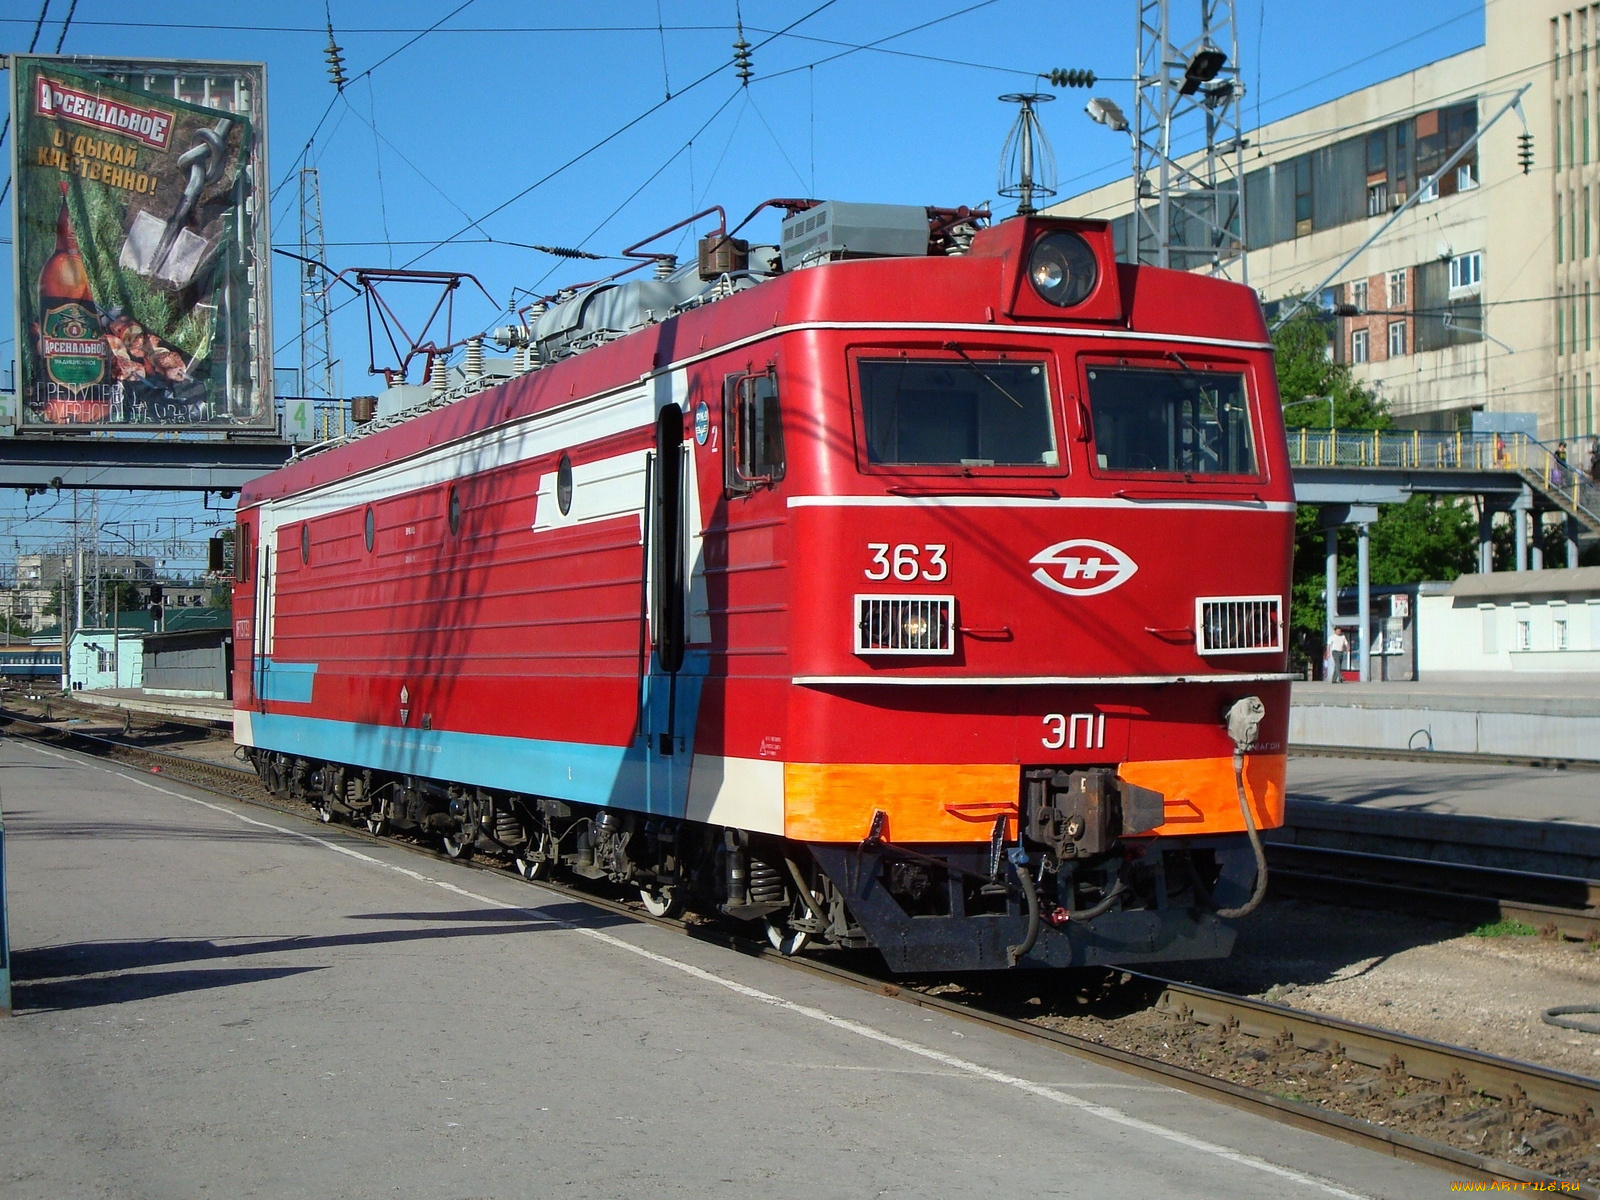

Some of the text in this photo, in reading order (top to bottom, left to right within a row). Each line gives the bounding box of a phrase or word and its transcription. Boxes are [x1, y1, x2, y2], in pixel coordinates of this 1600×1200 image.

[42, 83, 168, 142] АРСЕНАЛЬНОЕ
[53, 128, 138, 168] ОТДЫХАЙ
[45, 340, 107, 355] АРСЕНАЛЬНОЕ
[294, 402, 306, 430] 4
[711, 425, 718, 453] 2
[864, 543, 948, 581] 363
